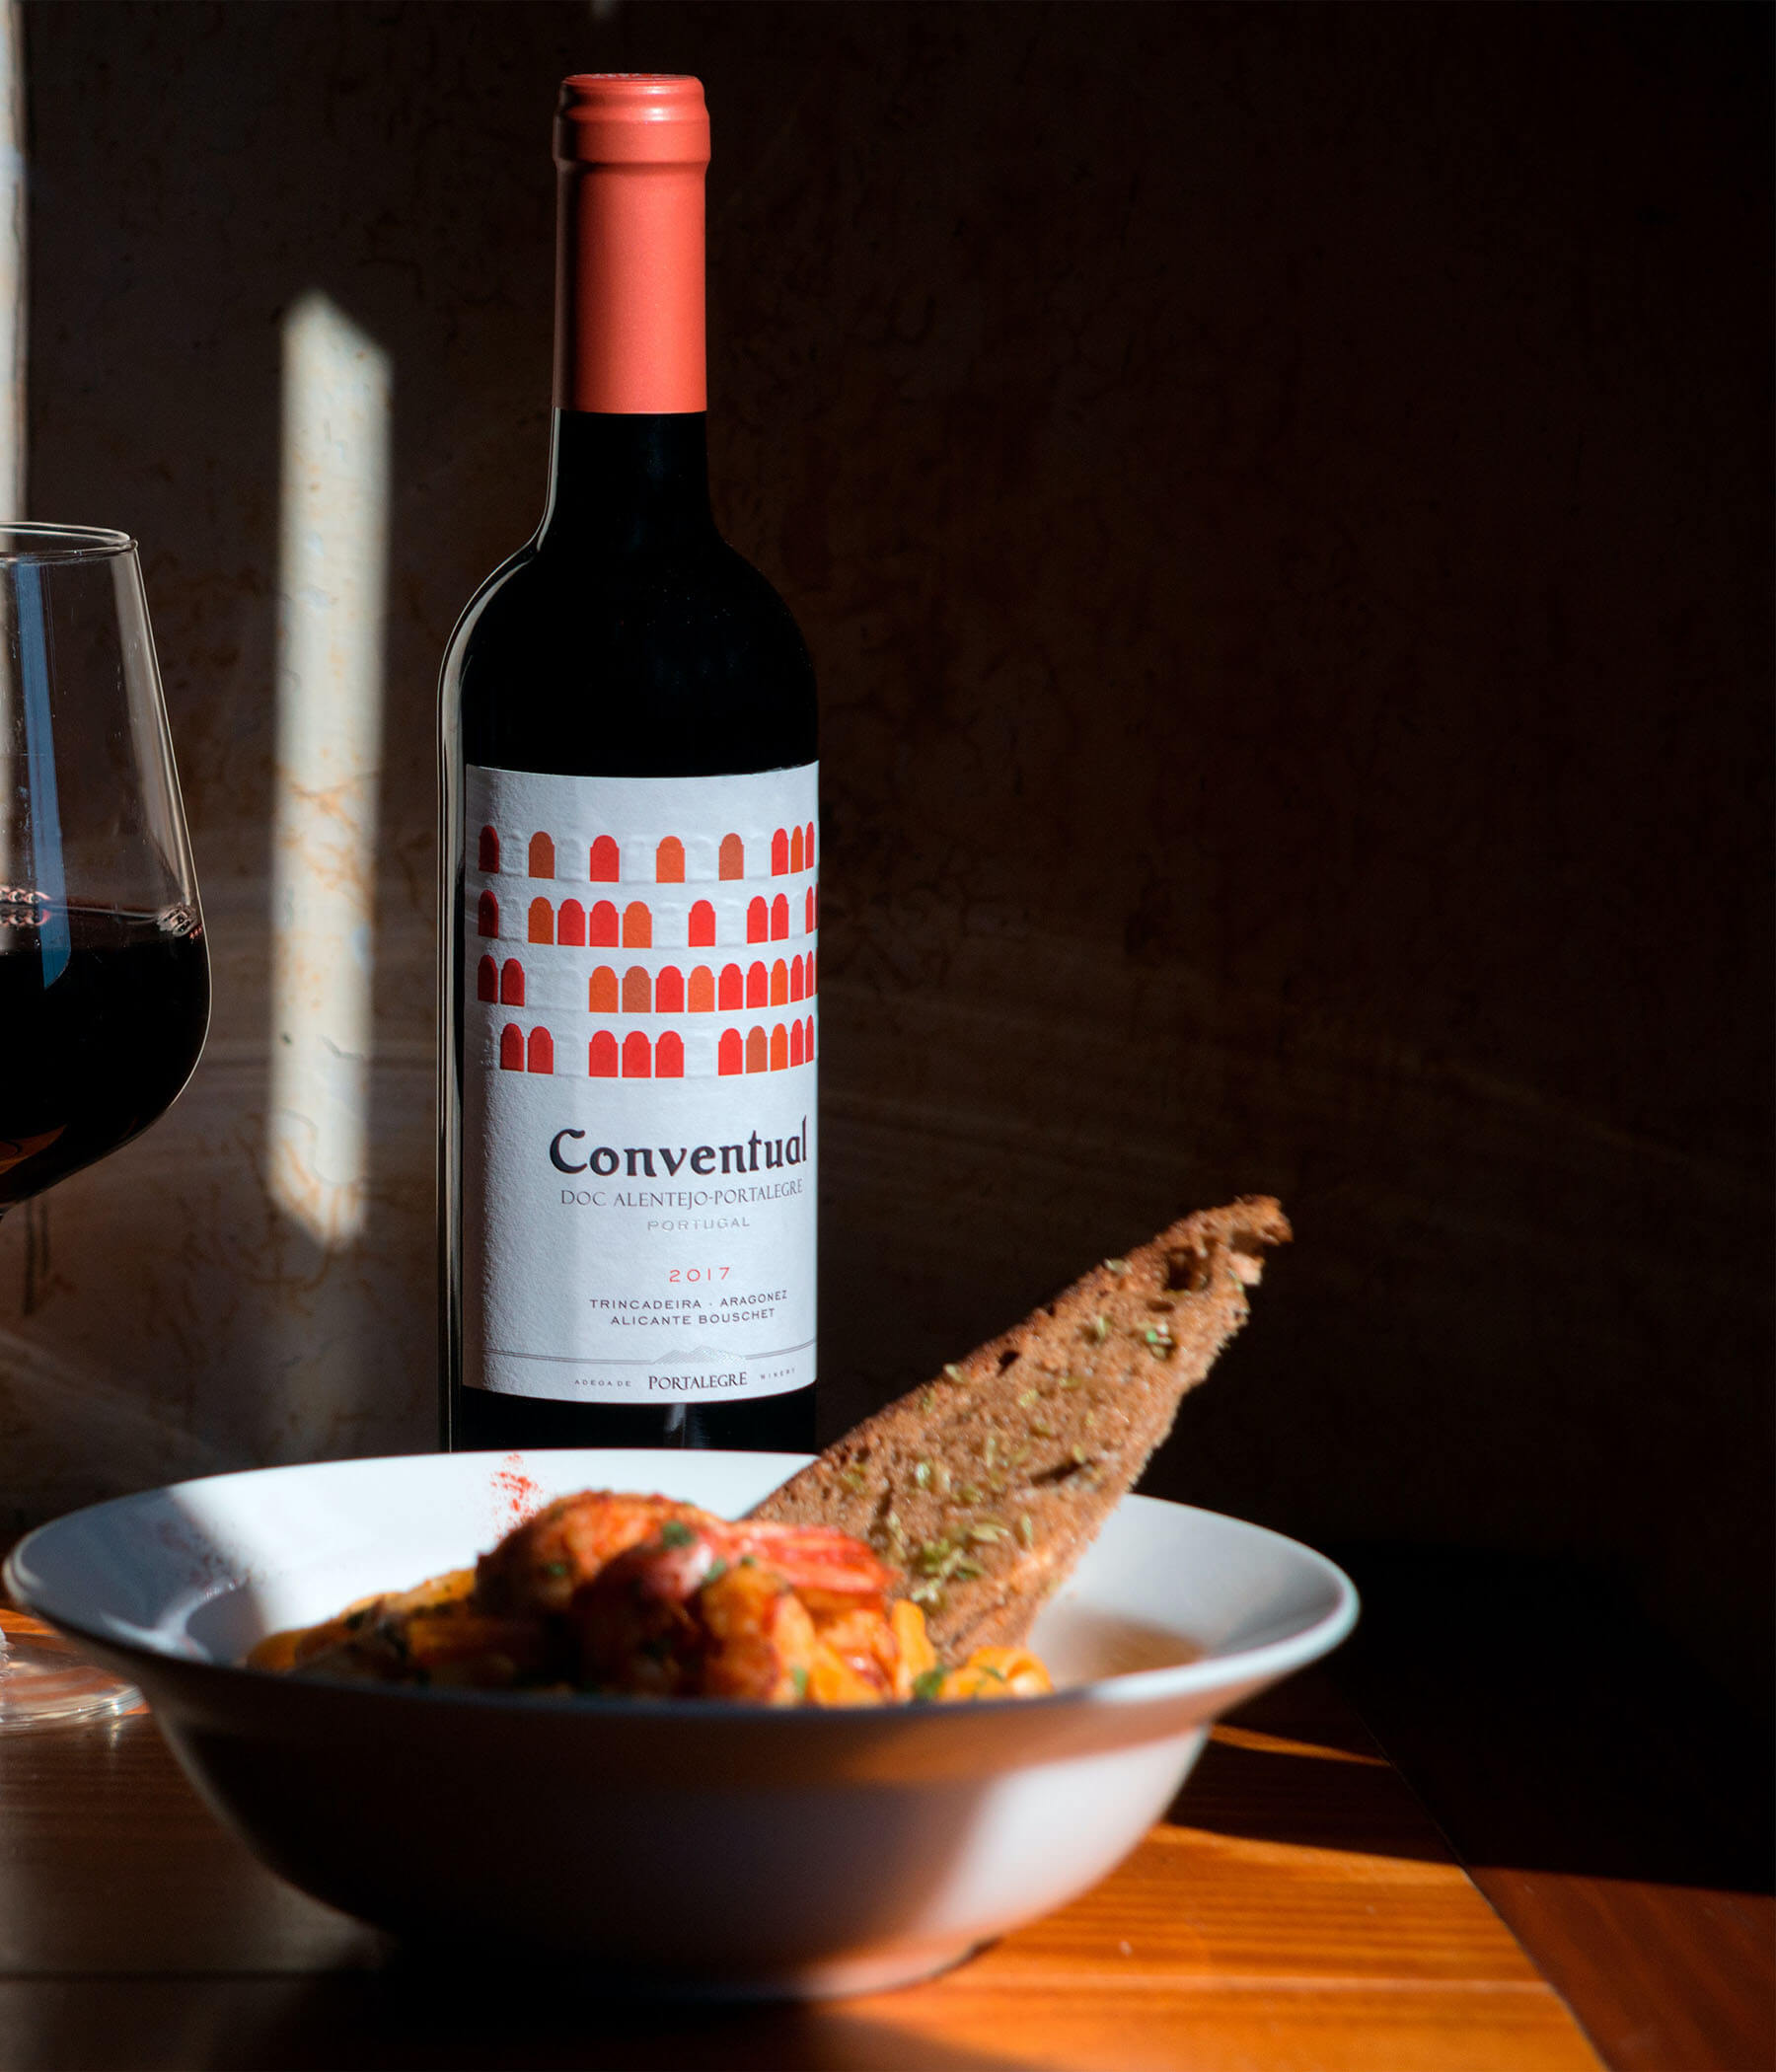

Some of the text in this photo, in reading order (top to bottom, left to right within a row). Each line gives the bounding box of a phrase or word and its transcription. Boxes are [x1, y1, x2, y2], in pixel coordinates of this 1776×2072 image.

[550, 1115, 807, 1177] Conventual
[560, 1179, 803, 1211] DOC ALENTEJO-PORTALEGRE
[647, 1217, 751, 1231] PORTUGAL
[669, 1266, 730, 1283] 2017
[589, 1290, 787, 1309] TRINCADEIRA ARAGONEZ
[610, 1307, 776, 1326] ALICANTE BOUSCHET
[648, 1372, 748, 1391] PORTALEGRE
